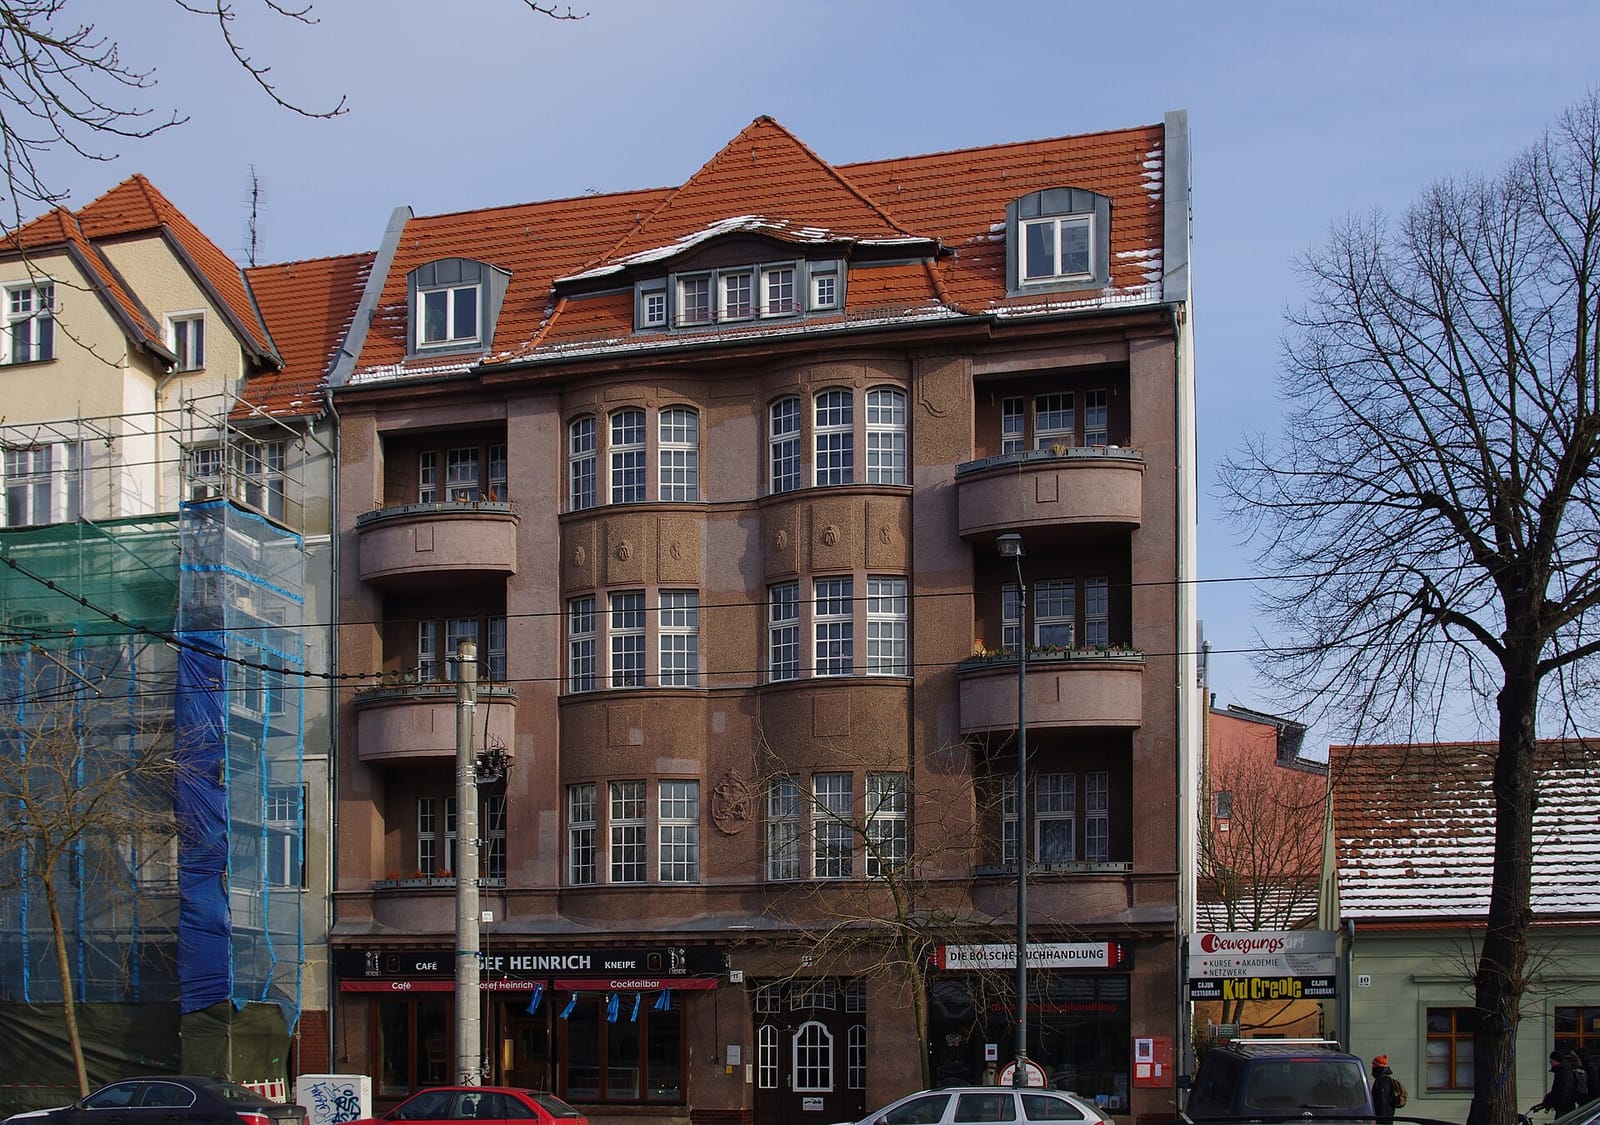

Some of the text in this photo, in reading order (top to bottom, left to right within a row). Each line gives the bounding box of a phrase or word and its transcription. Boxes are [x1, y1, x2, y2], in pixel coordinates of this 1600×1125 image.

[950, 952, 967, 961] DIE
[415, 961, 438, 971] CAFÉ
[479, 955, 592, 970] SEF HEINRICH
[604, 960, 636, 969] KNEIPE
[1241, 958, 1279, 967] AKADEMIE
[1209, 968, 1248, 976] NETZWERK
[391, 982, 412, 991] Café
[479, 981, 499, 991] osef
[610, 980, 660, 989] Cocktailbar
[1223, 977, 1302, 1000] Kid Creole
